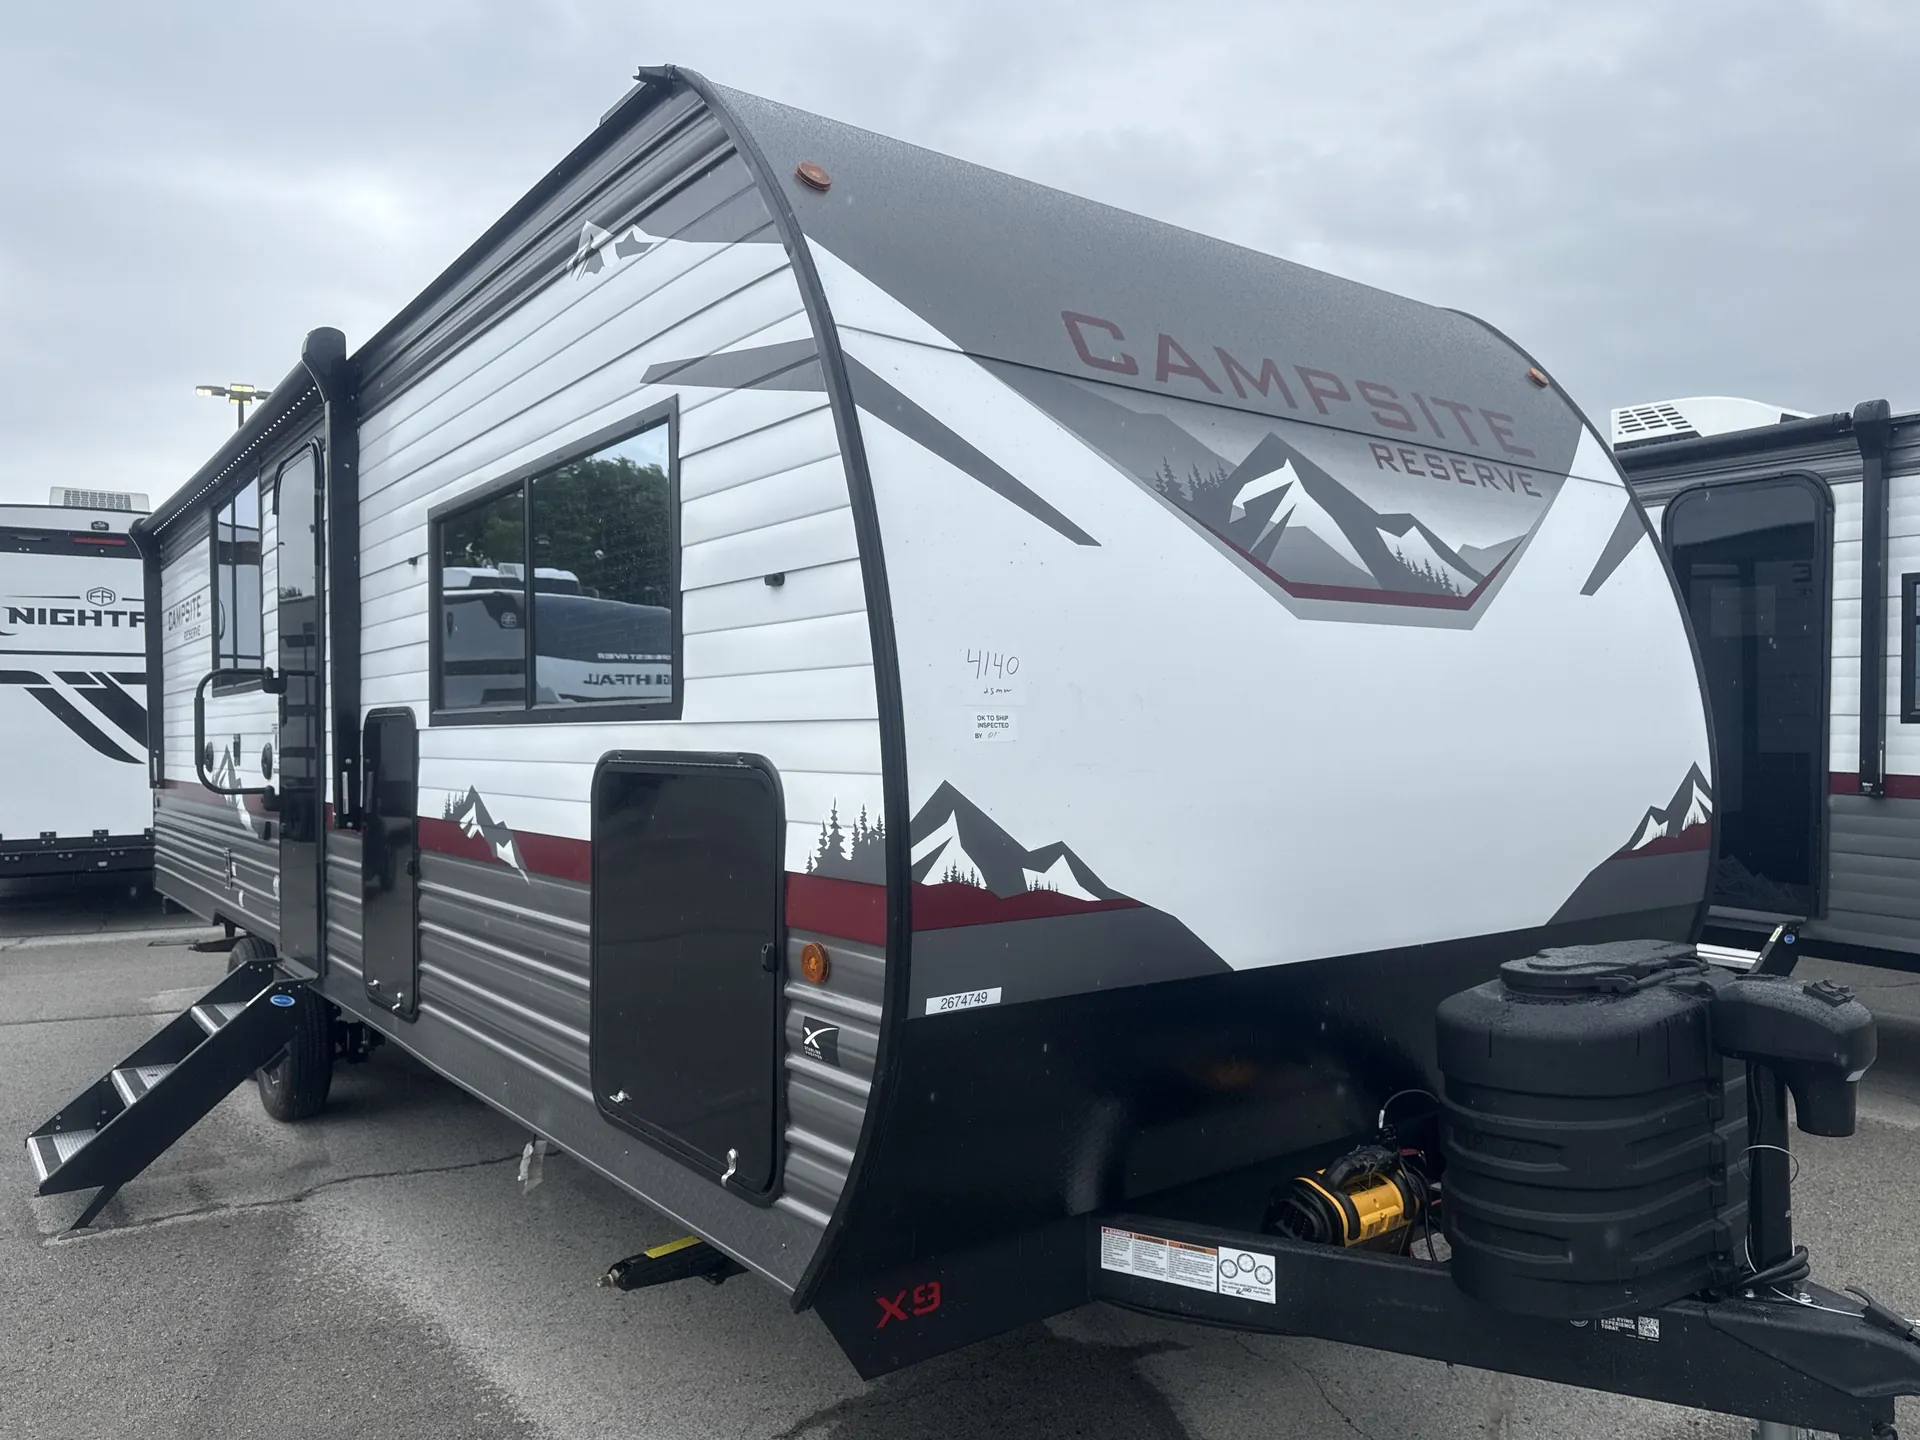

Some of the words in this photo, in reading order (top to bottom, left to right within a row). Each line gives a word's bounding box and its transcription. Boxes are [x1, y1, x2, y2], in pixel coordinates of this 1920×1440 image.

[1060, 310, 1536, 459] CAMPSITE
[1368, 442, 1543, 498] RESERVE
[168, 595, 201, 631] CAMPSITE
[183, 625, 201, 641] RESERVE
[967, 648, 1020, 679] 4140
[940, 991, 988, 1010] 2674749
[1601, 1319, 1636, 1329] EXPERIENCE
